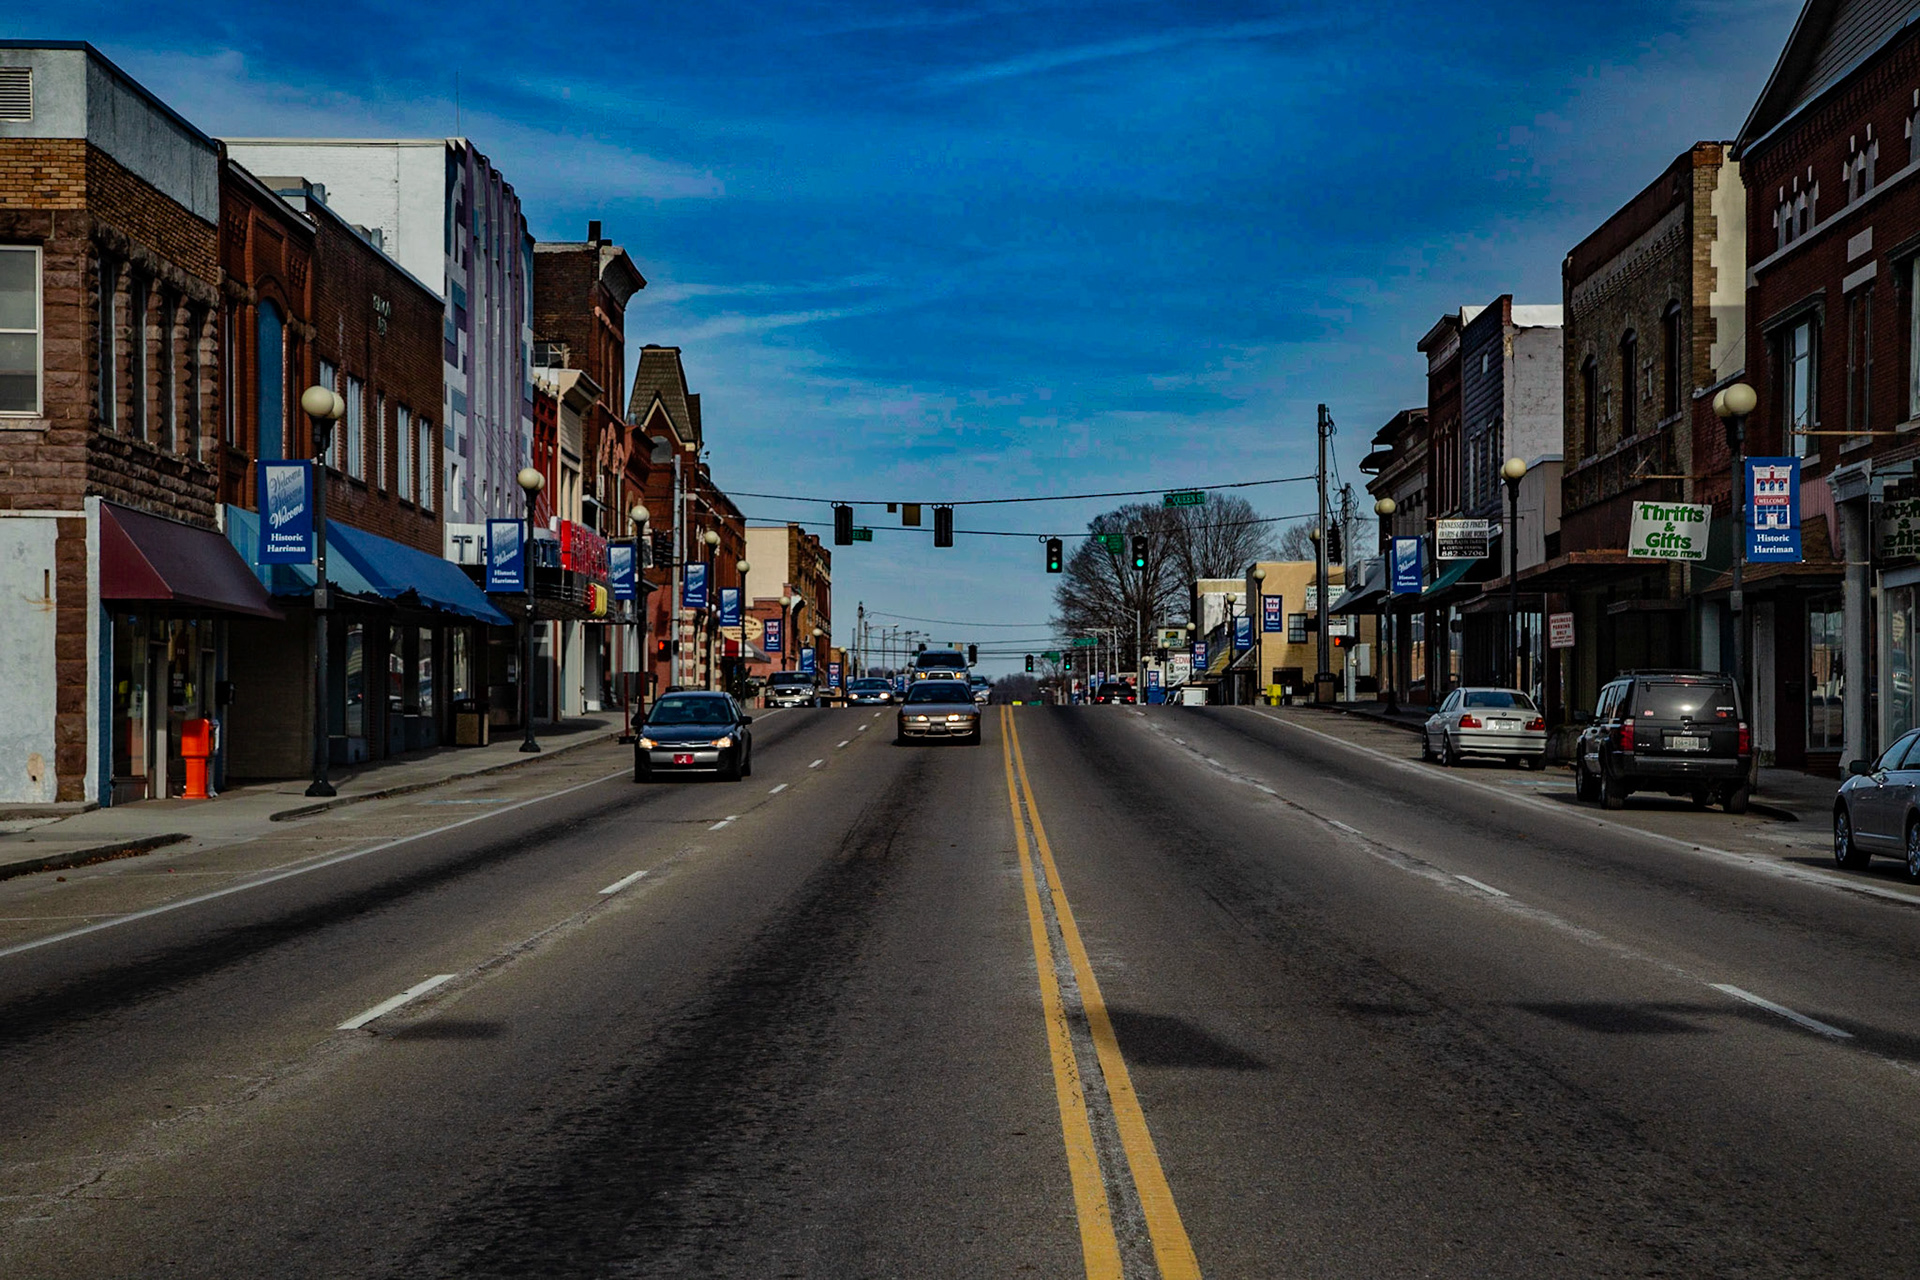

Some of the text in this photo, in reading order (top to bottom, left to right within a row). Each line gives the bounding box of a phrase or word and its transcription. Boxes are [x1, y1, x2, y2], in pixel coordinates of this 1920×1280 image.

[270, 469, 302, 493] Welcome
[270, 487, 303, 510] Welcome
[1174, 494, 1204, 505] QUEEN ST
[269, 503, 304, 529] Welcome
[1640, 504, 1704, 522] Thrifts
[1664, 522, 1676, 532] &
[271, 533, 304, 541] Historic
[1646, 532, 1692, 549] Gifts
[1757, 534, 1790, 542] Historic
[267, 544, 306, 552] Harriman
[1754, 545, 1794, 554] Harriman
